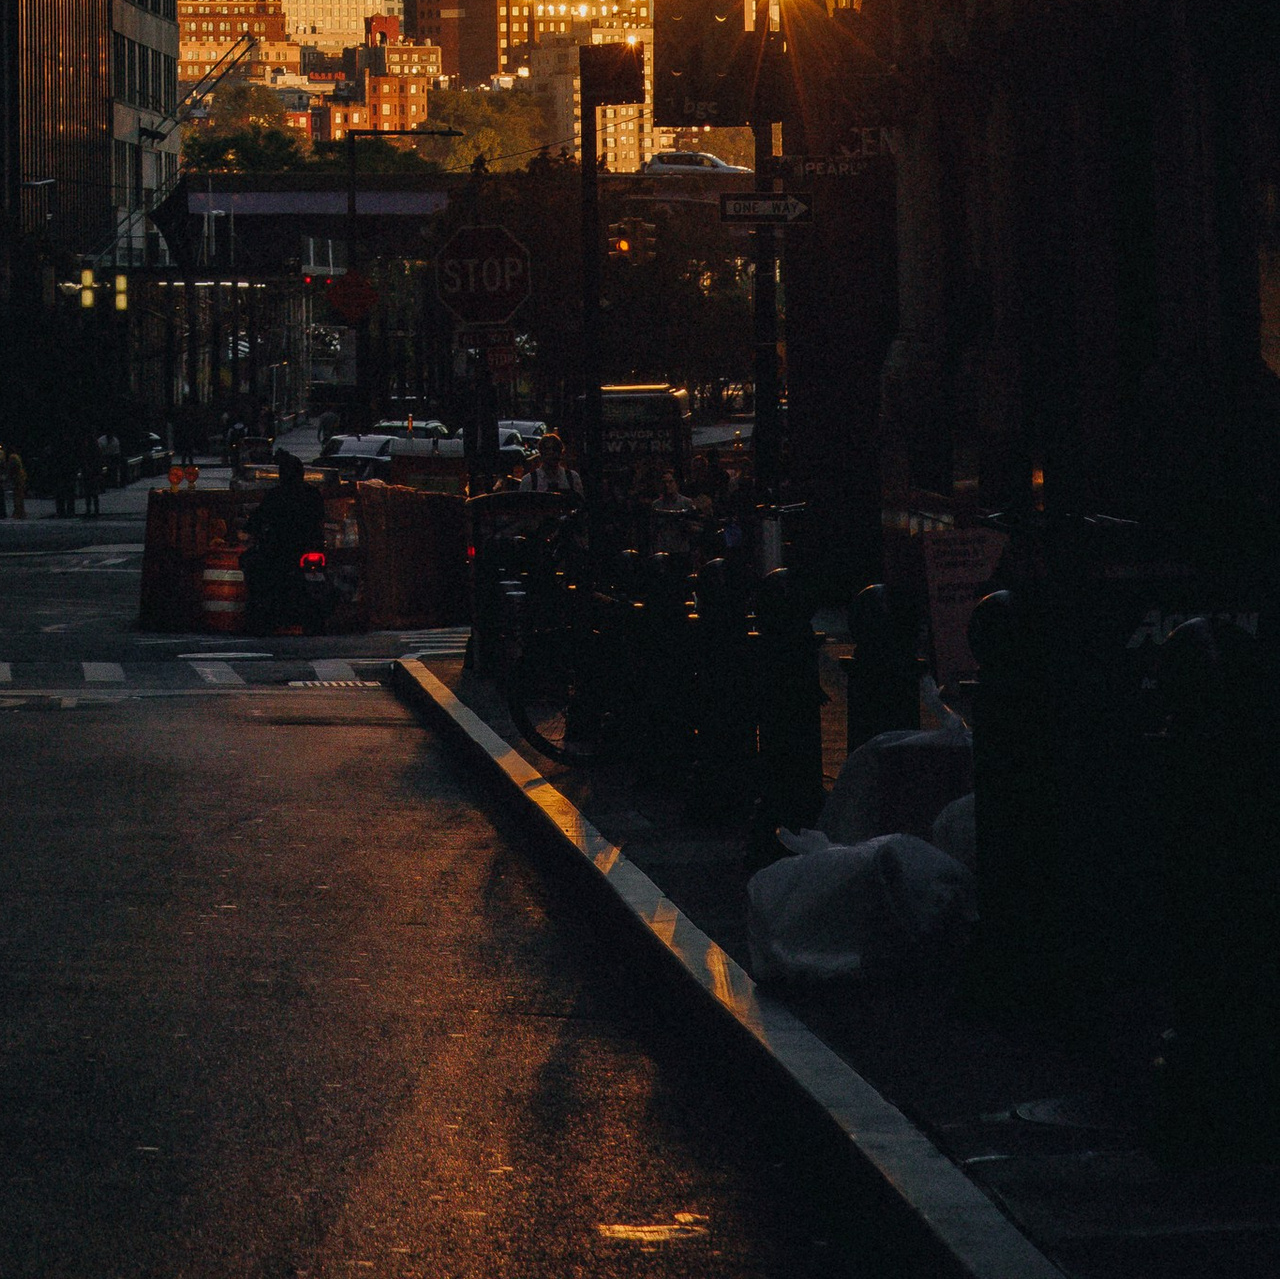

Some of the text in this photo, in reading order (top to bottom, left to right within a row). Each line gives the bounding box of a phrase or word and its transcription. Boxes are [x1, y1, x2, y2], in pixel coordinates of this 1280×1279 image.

[683, 96, 718, 120] bgc
[804, 161, 859, 176] PEARL
[733, 201, 799, 214] ONE WAY
[443, 256, 523, 293] STOP
